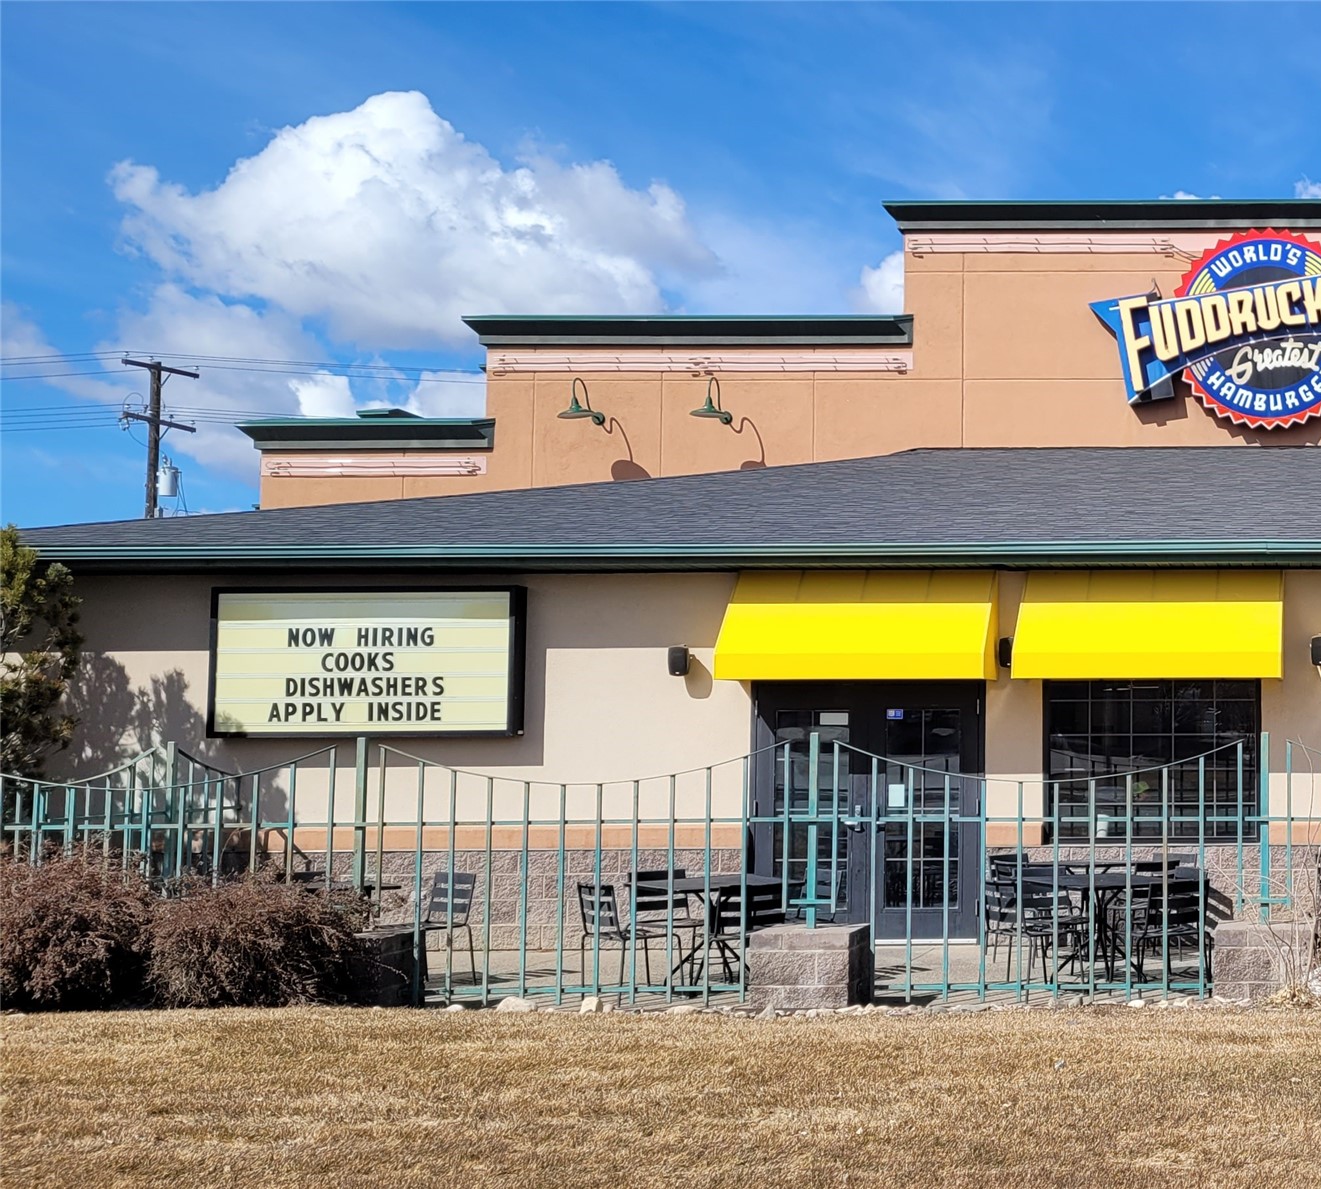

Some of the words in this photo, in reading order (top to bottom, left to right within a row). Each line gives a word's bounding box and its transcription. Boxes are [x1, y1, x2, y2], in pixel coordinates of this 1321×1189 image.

[1210, 243, 1302, 278] WORLD'S
[287, 627, 335, 647] NOW
[356, 627, 435, 647] HIRING
[321, 652, 395, 672] COOKS
[285, 676, 445, 697] DISHWASHERS
[268, 702, 346, 722] APPLY
[368, 701, 442, 721] INSIDE
